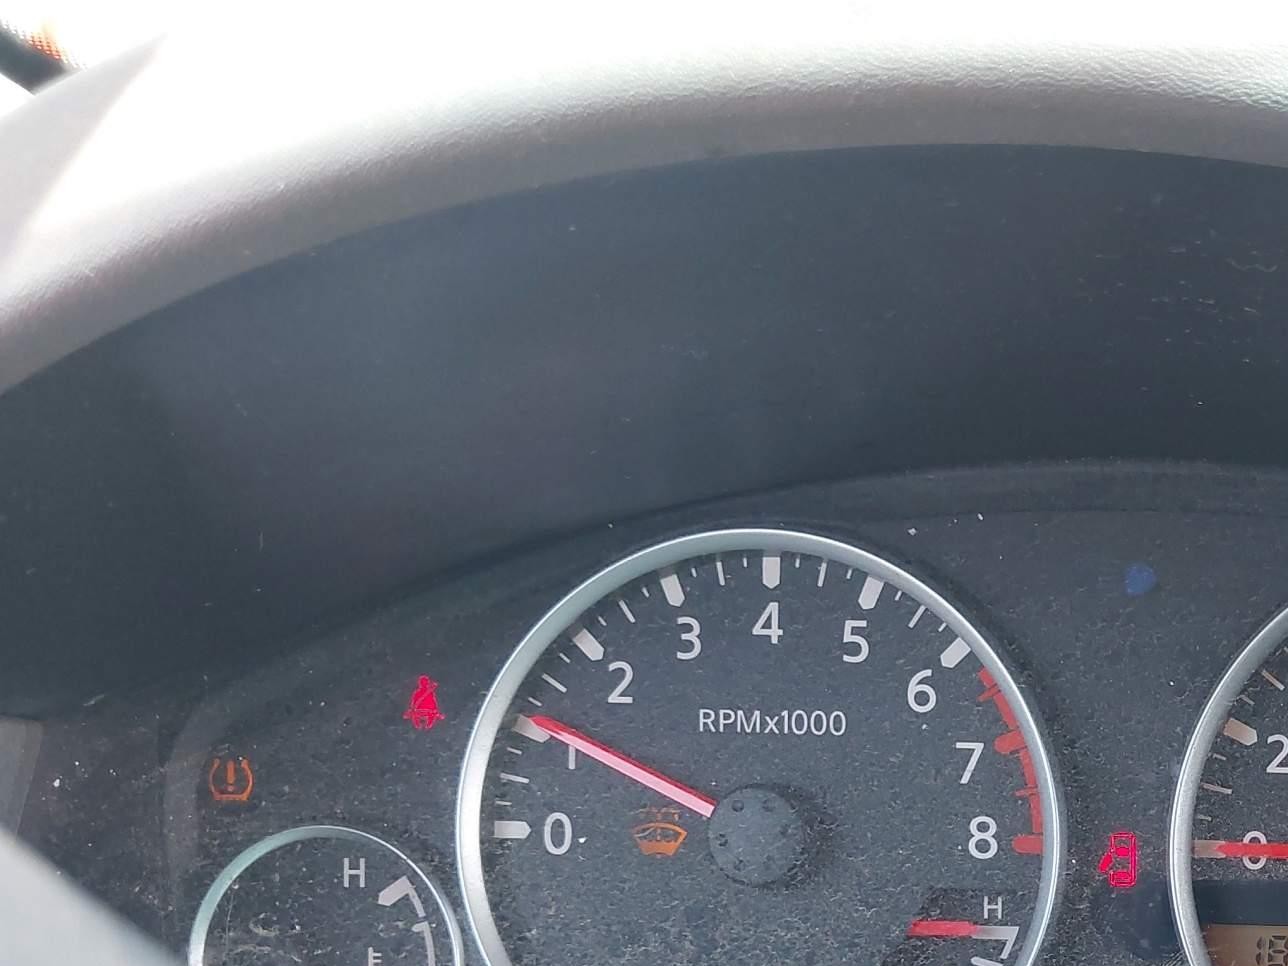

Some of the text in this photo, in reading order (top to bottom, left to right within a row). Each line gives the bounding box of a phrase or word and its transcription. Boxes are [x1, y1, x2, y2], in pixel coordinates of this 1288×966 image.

[676, 616, 702, 659] 3
[751, 602, 783, 644] 4
[843, 620, 869, 663] 5
[607, 661, 634, 704] 2
[907, 669, 936, 712] 6
[698, 710, 846, 736] RPMx1000
[956, 742, 984, 783] 7
[544, 812, 572, 855] 0
[968, 816, 998, 859] 8
[343, 858, 365, 888] H
[983, 896, 1003, 919] H
